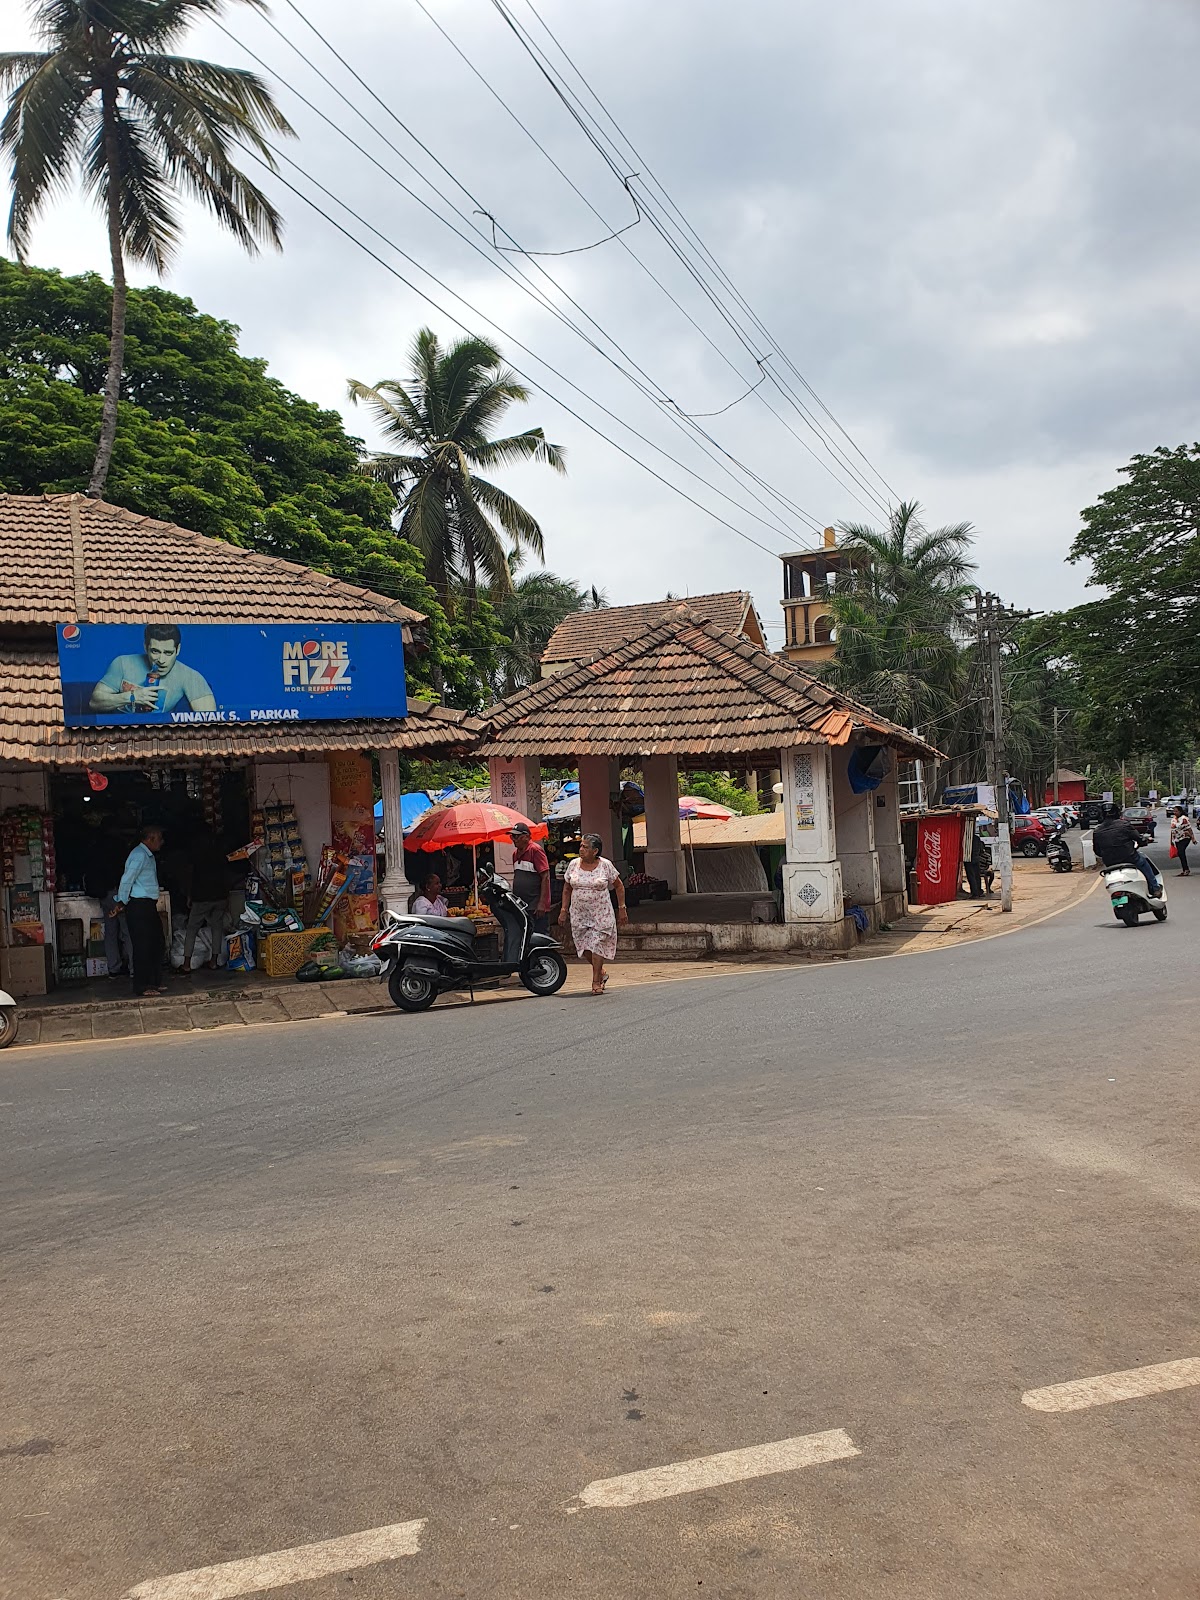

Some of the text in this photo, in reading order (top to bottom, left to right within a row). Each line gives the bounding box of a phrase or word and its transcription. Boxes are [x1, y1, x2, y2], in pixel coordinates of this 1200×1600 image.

[283, 641, 349, 660] MORE
[283, 660, 352, 685] FIZZ
[171, 709, 299, 722] VINAYAK S. PARKAR
[924, 829, 942, 884] Coca-Cola
